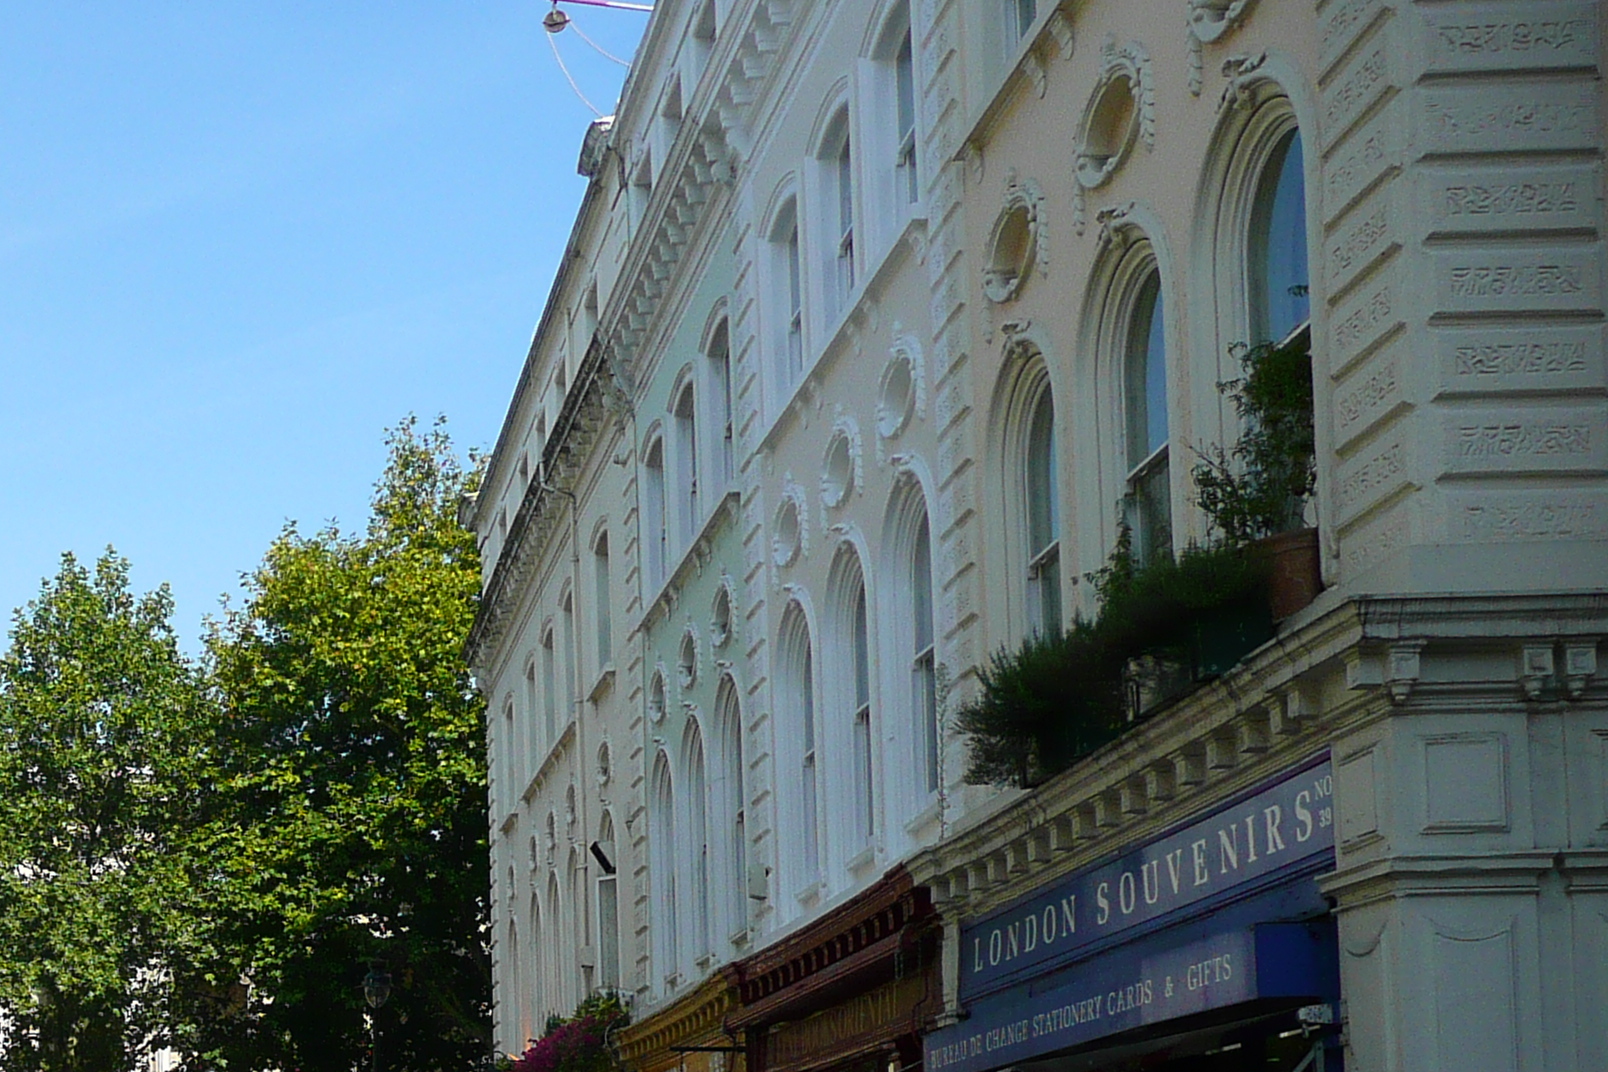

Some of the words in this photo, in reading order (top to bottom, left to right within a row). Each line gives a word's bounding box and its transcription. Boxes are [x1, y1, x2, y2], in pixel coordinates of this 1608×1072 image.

[1314, 775, 1333, 800] NO
[1318, 806, 1332, 828] 39
[974, 894, 1076, 973] LONDON
[1097, 790, 1313, 925] SOUVENIRS
[930, 1039, 967, 1069] BUREAU
[970, 1034, 982, 1057] DE
[986, 1019, 1029, 1051] CHANGE
[1032, 995, 1103, 1038] STATIONERY
[1107, 979, 1153, 1015] CARDS
[1164, 975, 1174, 998] &
[1187, 953, 1232, 991] GIFTS
